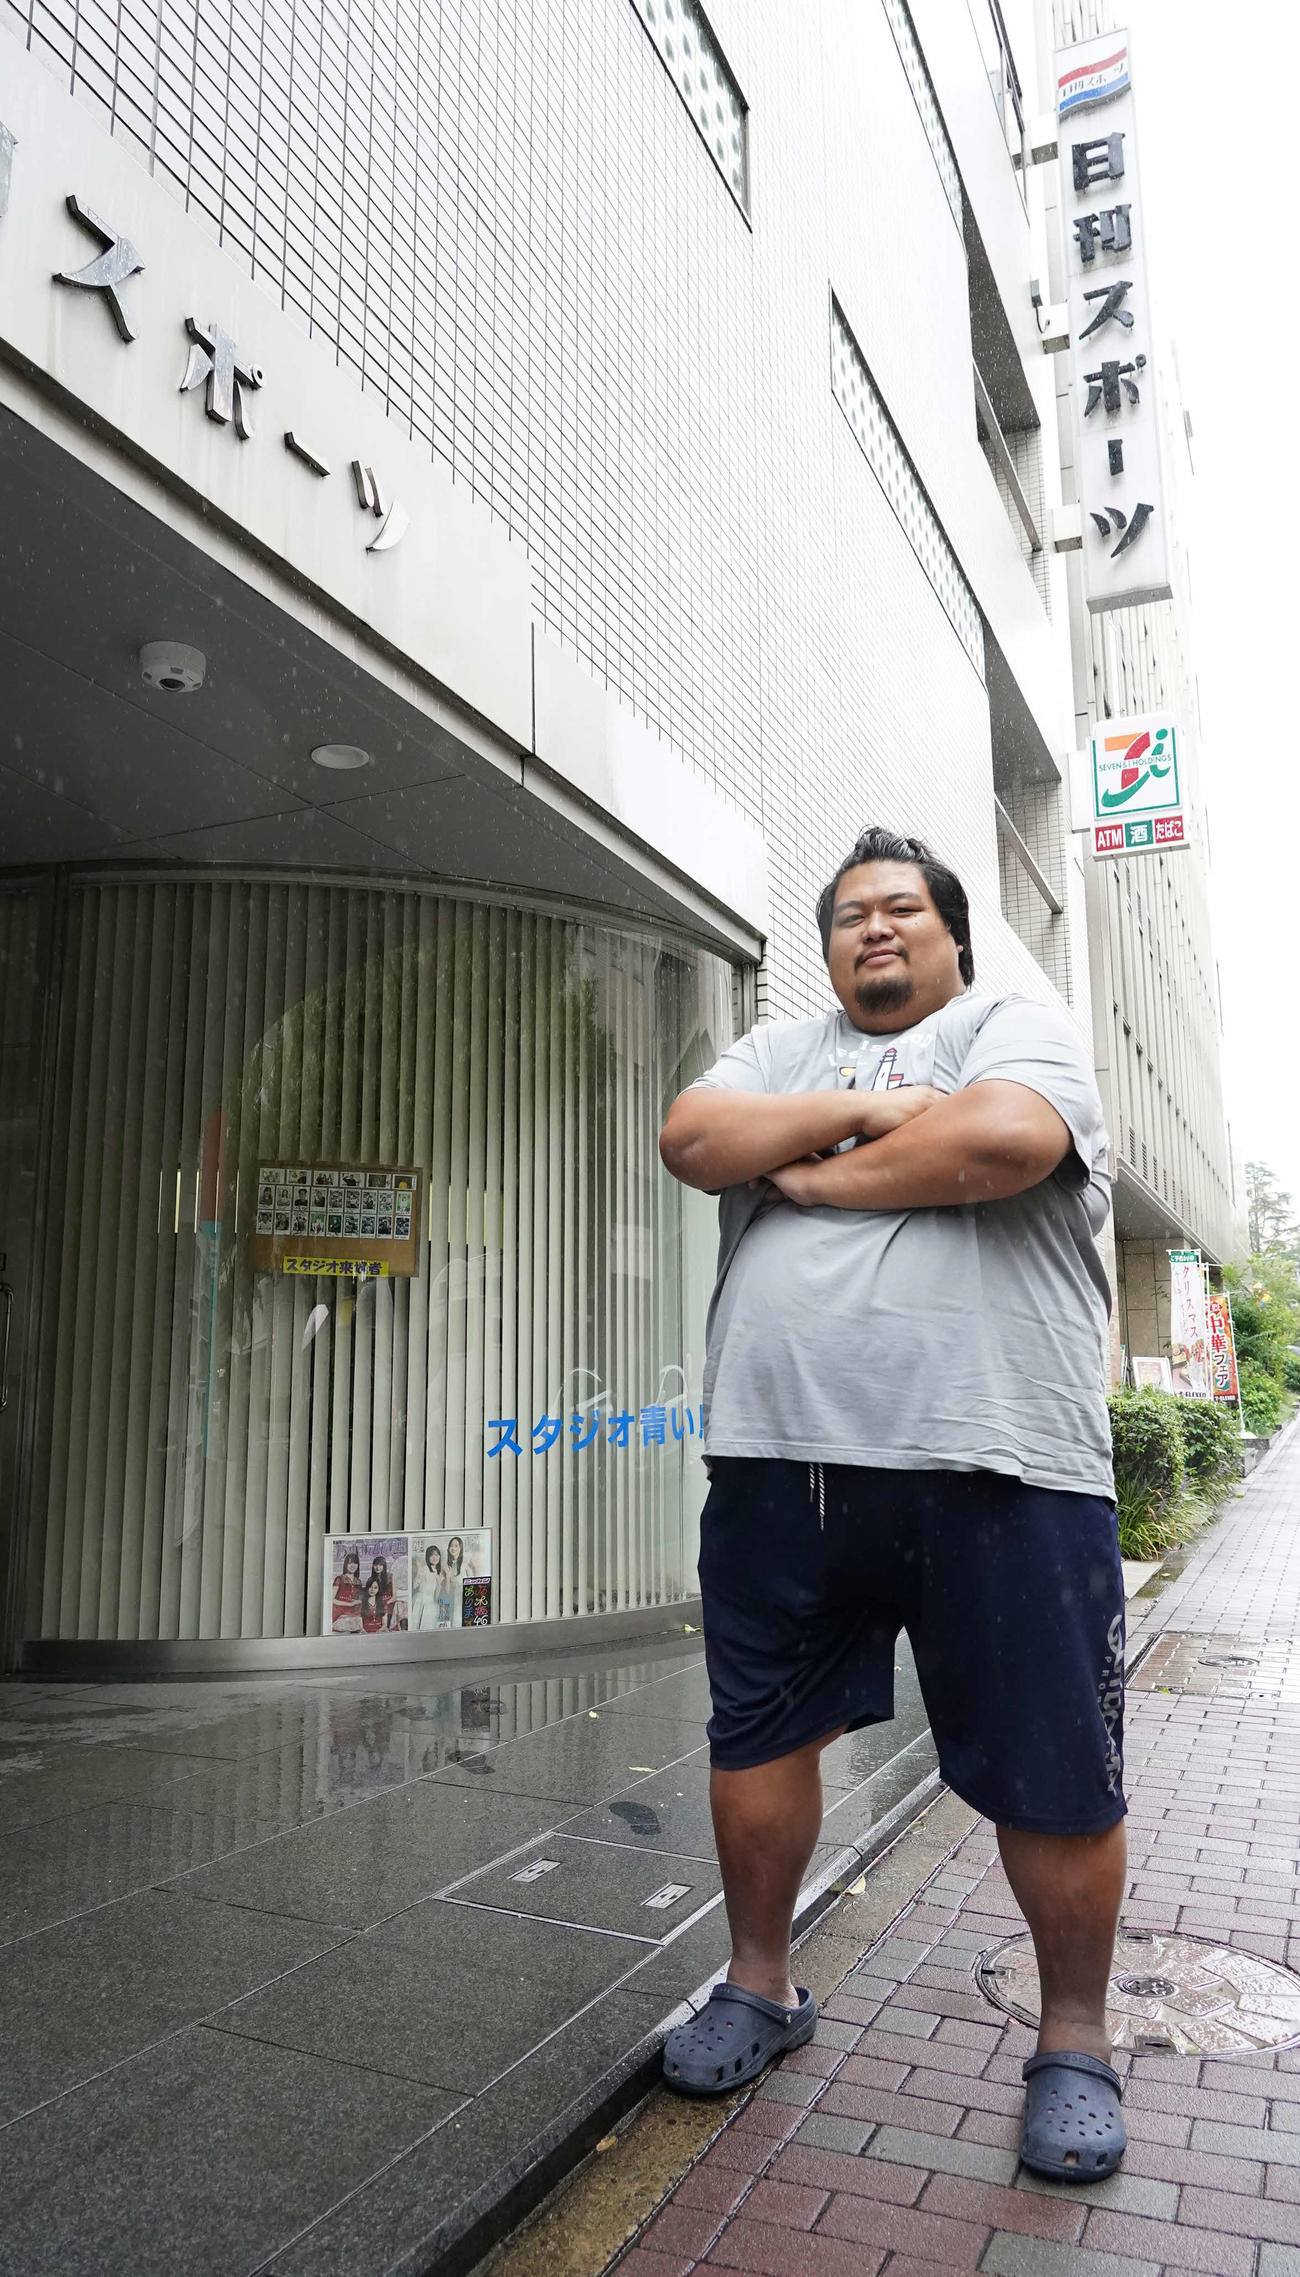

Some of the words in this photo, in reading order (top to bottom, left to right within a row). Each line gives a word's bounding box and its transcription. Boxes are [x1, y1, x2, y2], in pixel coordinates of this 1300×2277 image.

[1062, 62, 1124, 97] 日刊スポツ
[0, 120, 410, 553] スポーツ
[1071, 132, 1154, 559] 日刊スポーツ
[1097, 827, 1122, 848] ATM
[1130, 825, 1148, 844] 酒
[1155, 821, 1183, 840] たばこ
[1183, 1266, 1199, 1337] クリスマス
[1210, 1314, 1229, 1386] 中華フェア
[486, 1404, 704, 1458] スタジオ青い
